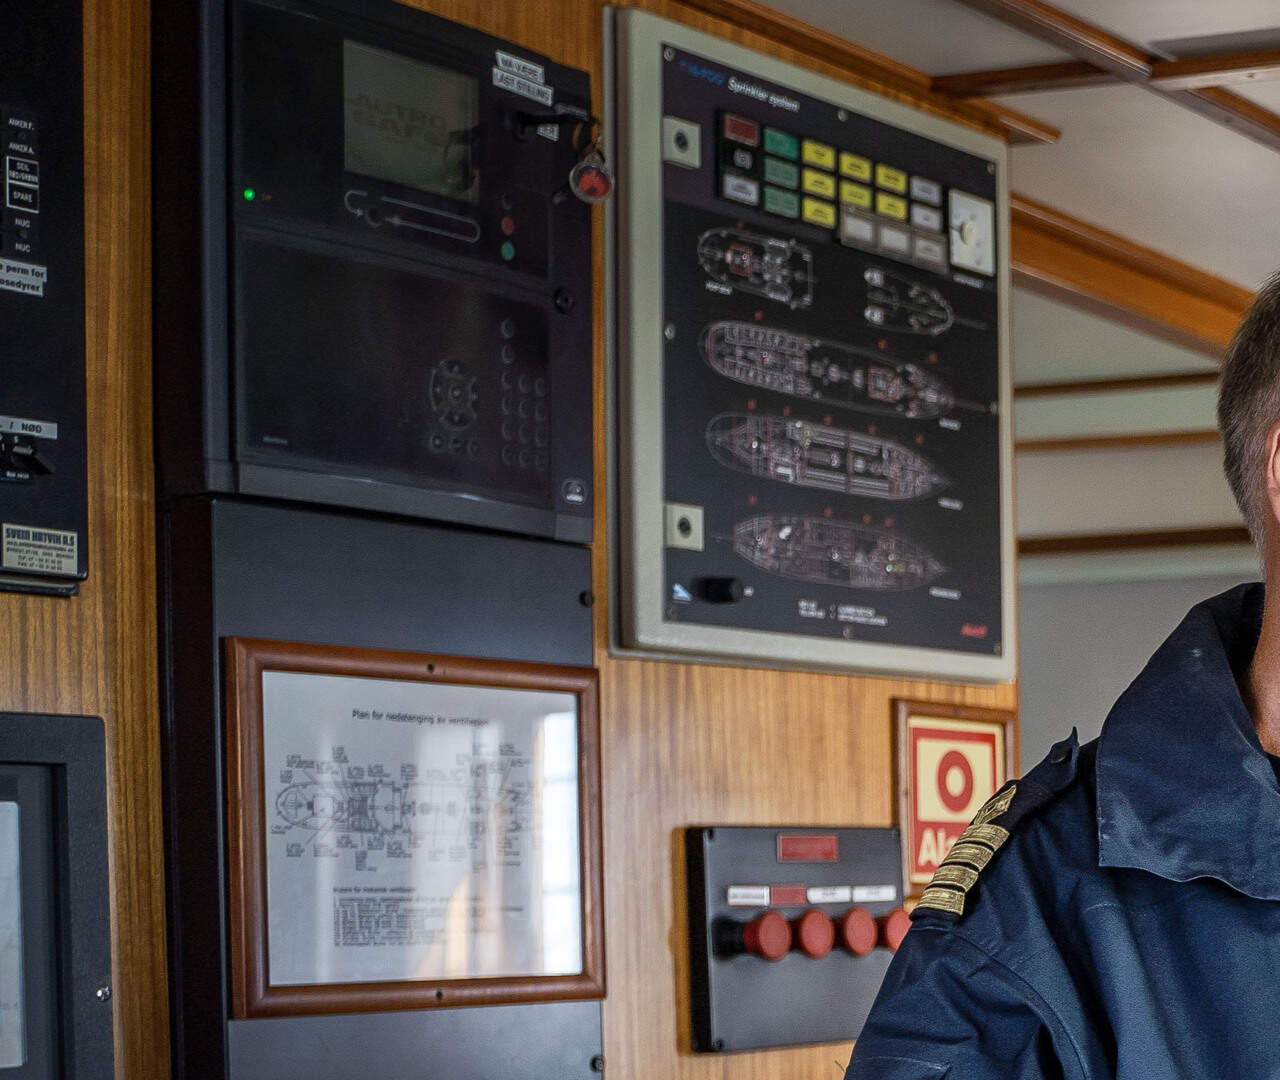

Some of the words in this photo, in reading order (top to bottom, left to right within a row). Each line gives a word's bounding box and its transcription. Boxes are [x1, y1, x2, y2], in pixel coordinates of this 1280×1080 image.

[6, 265, 29, 276] perm
[31, 267, 45, 279] for
[0, 279, 41, 292] osedyrer
